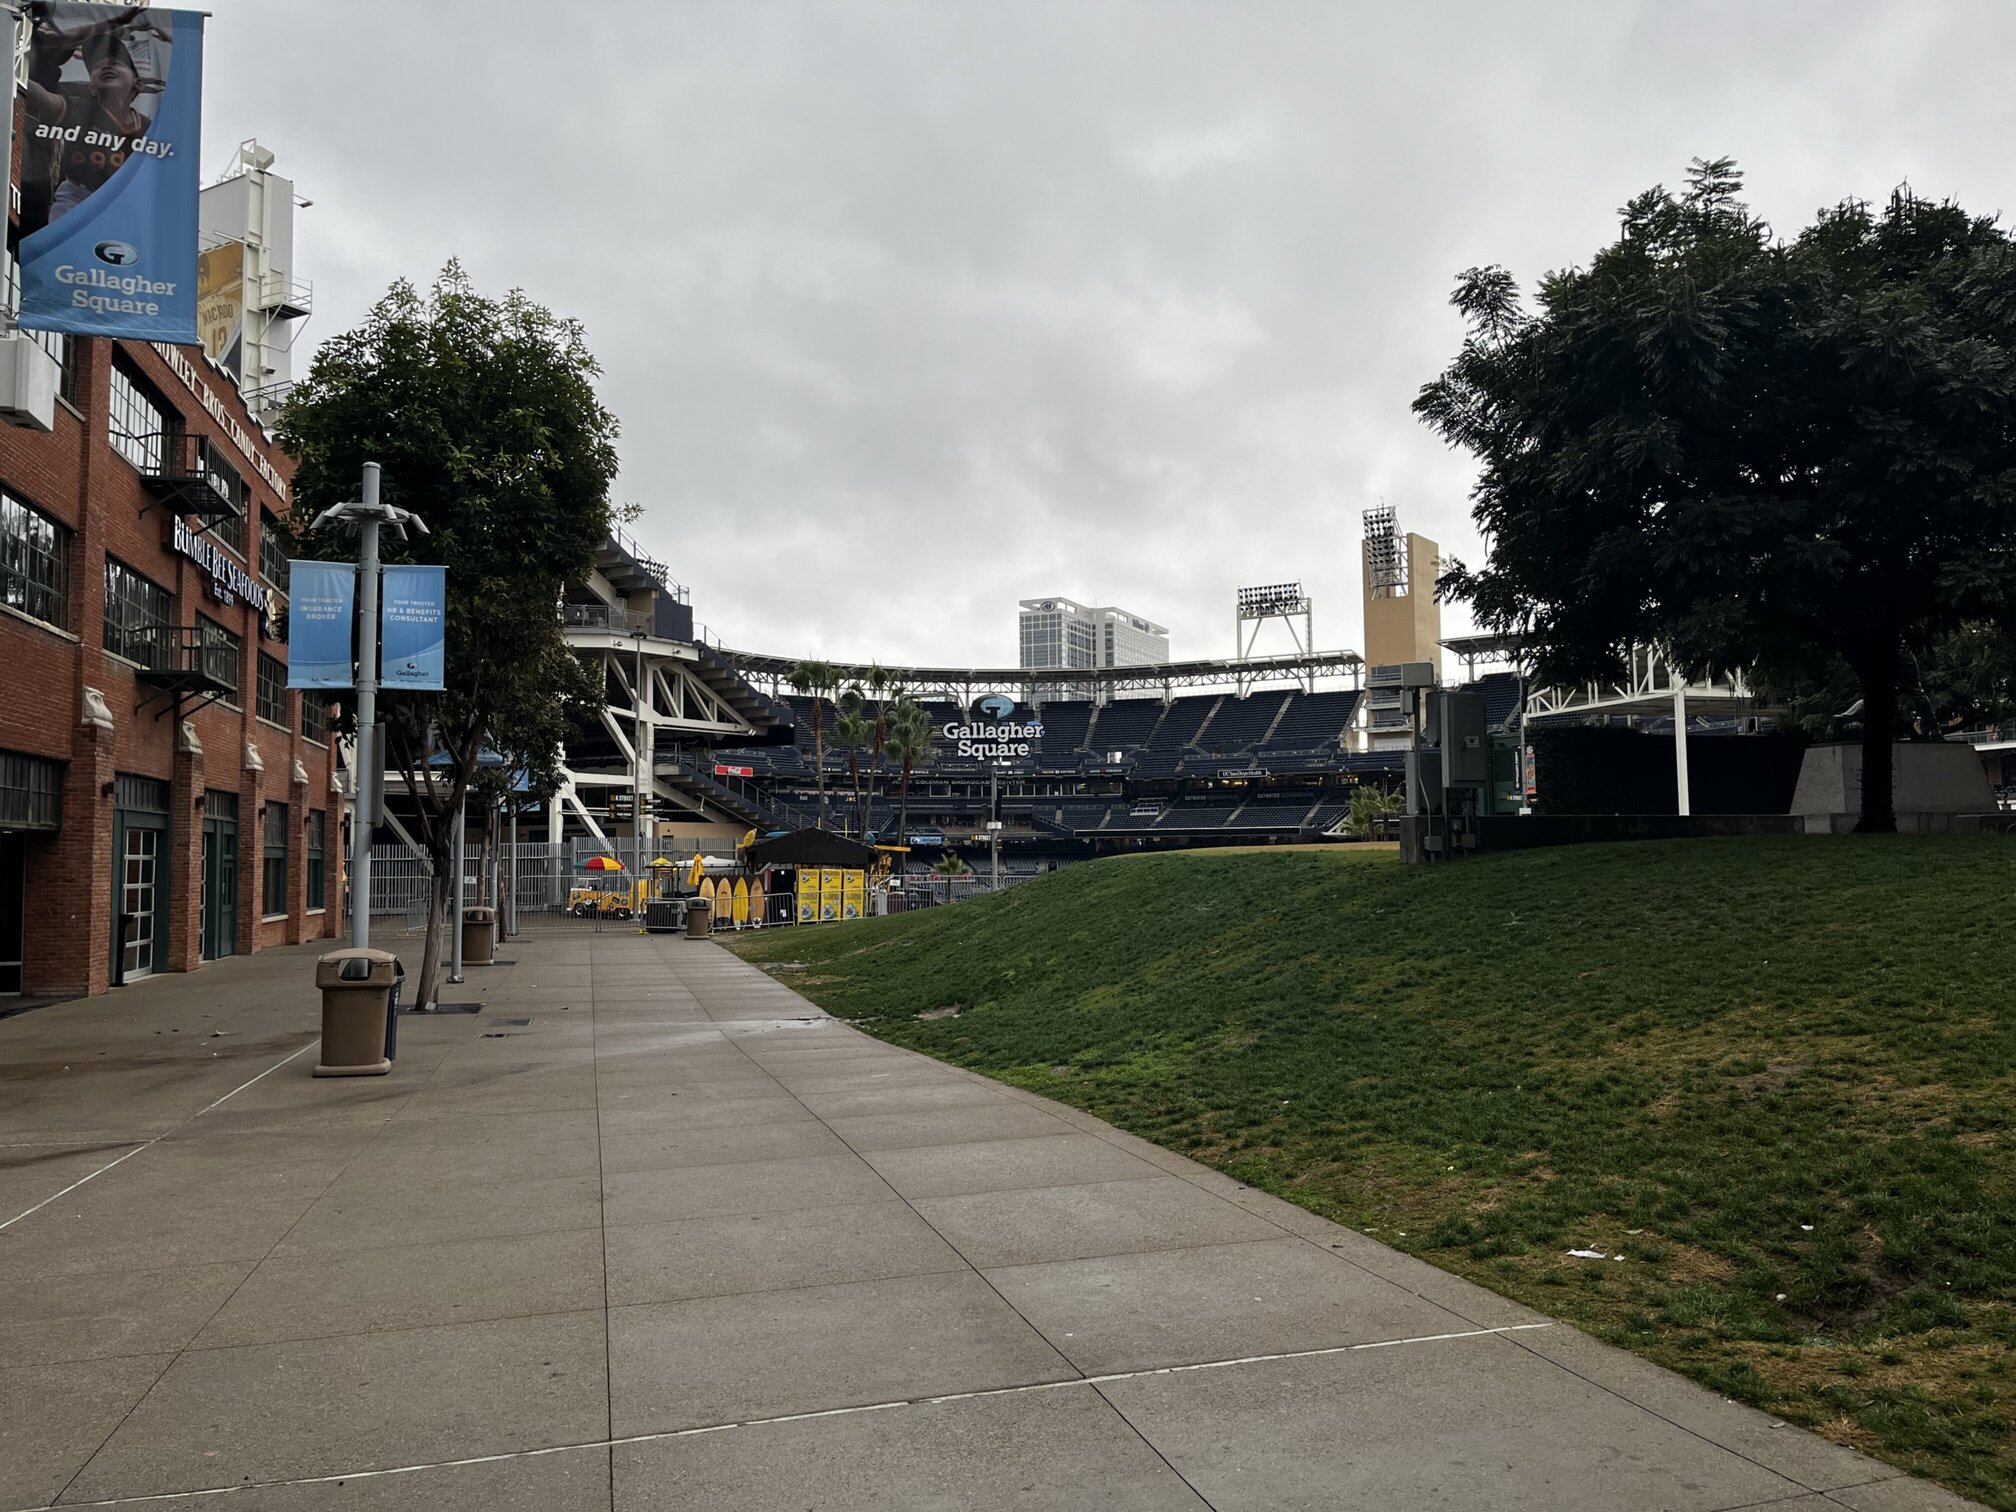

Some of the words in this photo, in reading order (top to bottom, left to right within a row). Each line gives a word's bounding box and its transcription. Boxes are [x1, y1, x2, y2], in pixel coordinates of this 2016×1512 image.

[35, 124, 81, 142] and
[84, 130, 126, 151] any
[131, 136, 174, 158] day.
[54, 265, 177, 295] Gallagher
[72, 289, 159, 316] Square
[151, 342, 197, 393] OWLEY
[230, 418, 256, 465] CANDY
[259, 454, 287, 502] FACTORY
[174, 514, 212, 571] BUMBLE
[212, 545, 227, 583] BEE
[227, 560, 264, 611] SEAFOODS
[300, 605, 343, 613] INSURANCE
[390, 614, 438, 623] CONSULTANT
[406, 608, 442, 616] BENEFITS
[943, 721, 1044, 742] Gallagher
[957, 740, 1030, 760] Square
